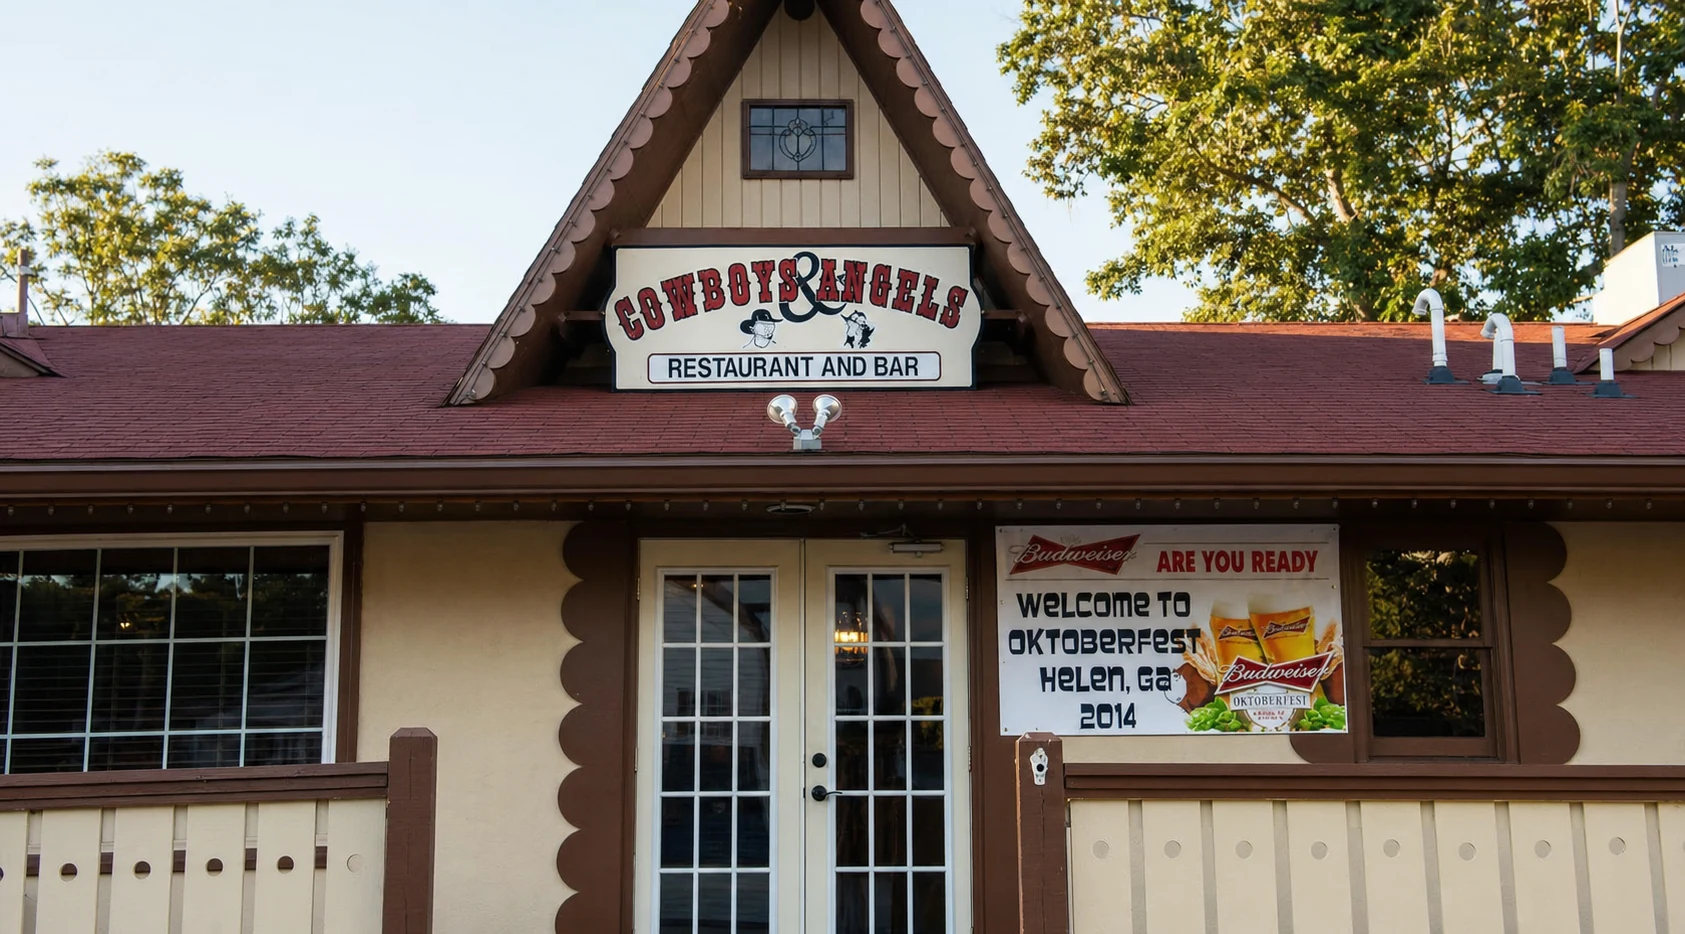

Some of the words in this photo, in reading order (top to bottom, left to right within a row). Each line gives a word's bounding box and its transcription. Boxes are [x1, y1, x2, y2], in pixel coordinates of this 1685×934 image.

[614, 258, 798, 341] COWBOYS
[777, 251, 847, 324] &
[815, 258, 969, 329] ANGELS
[668, 356, 814, 379] RESTAURANT
[821, 356, 867, 377] AND
[874, 355, 919, 377] BAR
[1009, 541, 1137, 566] Budweiser
[1156, 551, 1196, 573] ARE
[1203, 550, 1245, 573] YOU
[1251, 550, 1319, 573] READY
[1157, 590, 1191, 618] TO
[1219, 663, 1329, 683] Budweiser
[1080, 702, 1137, 729] 2014
